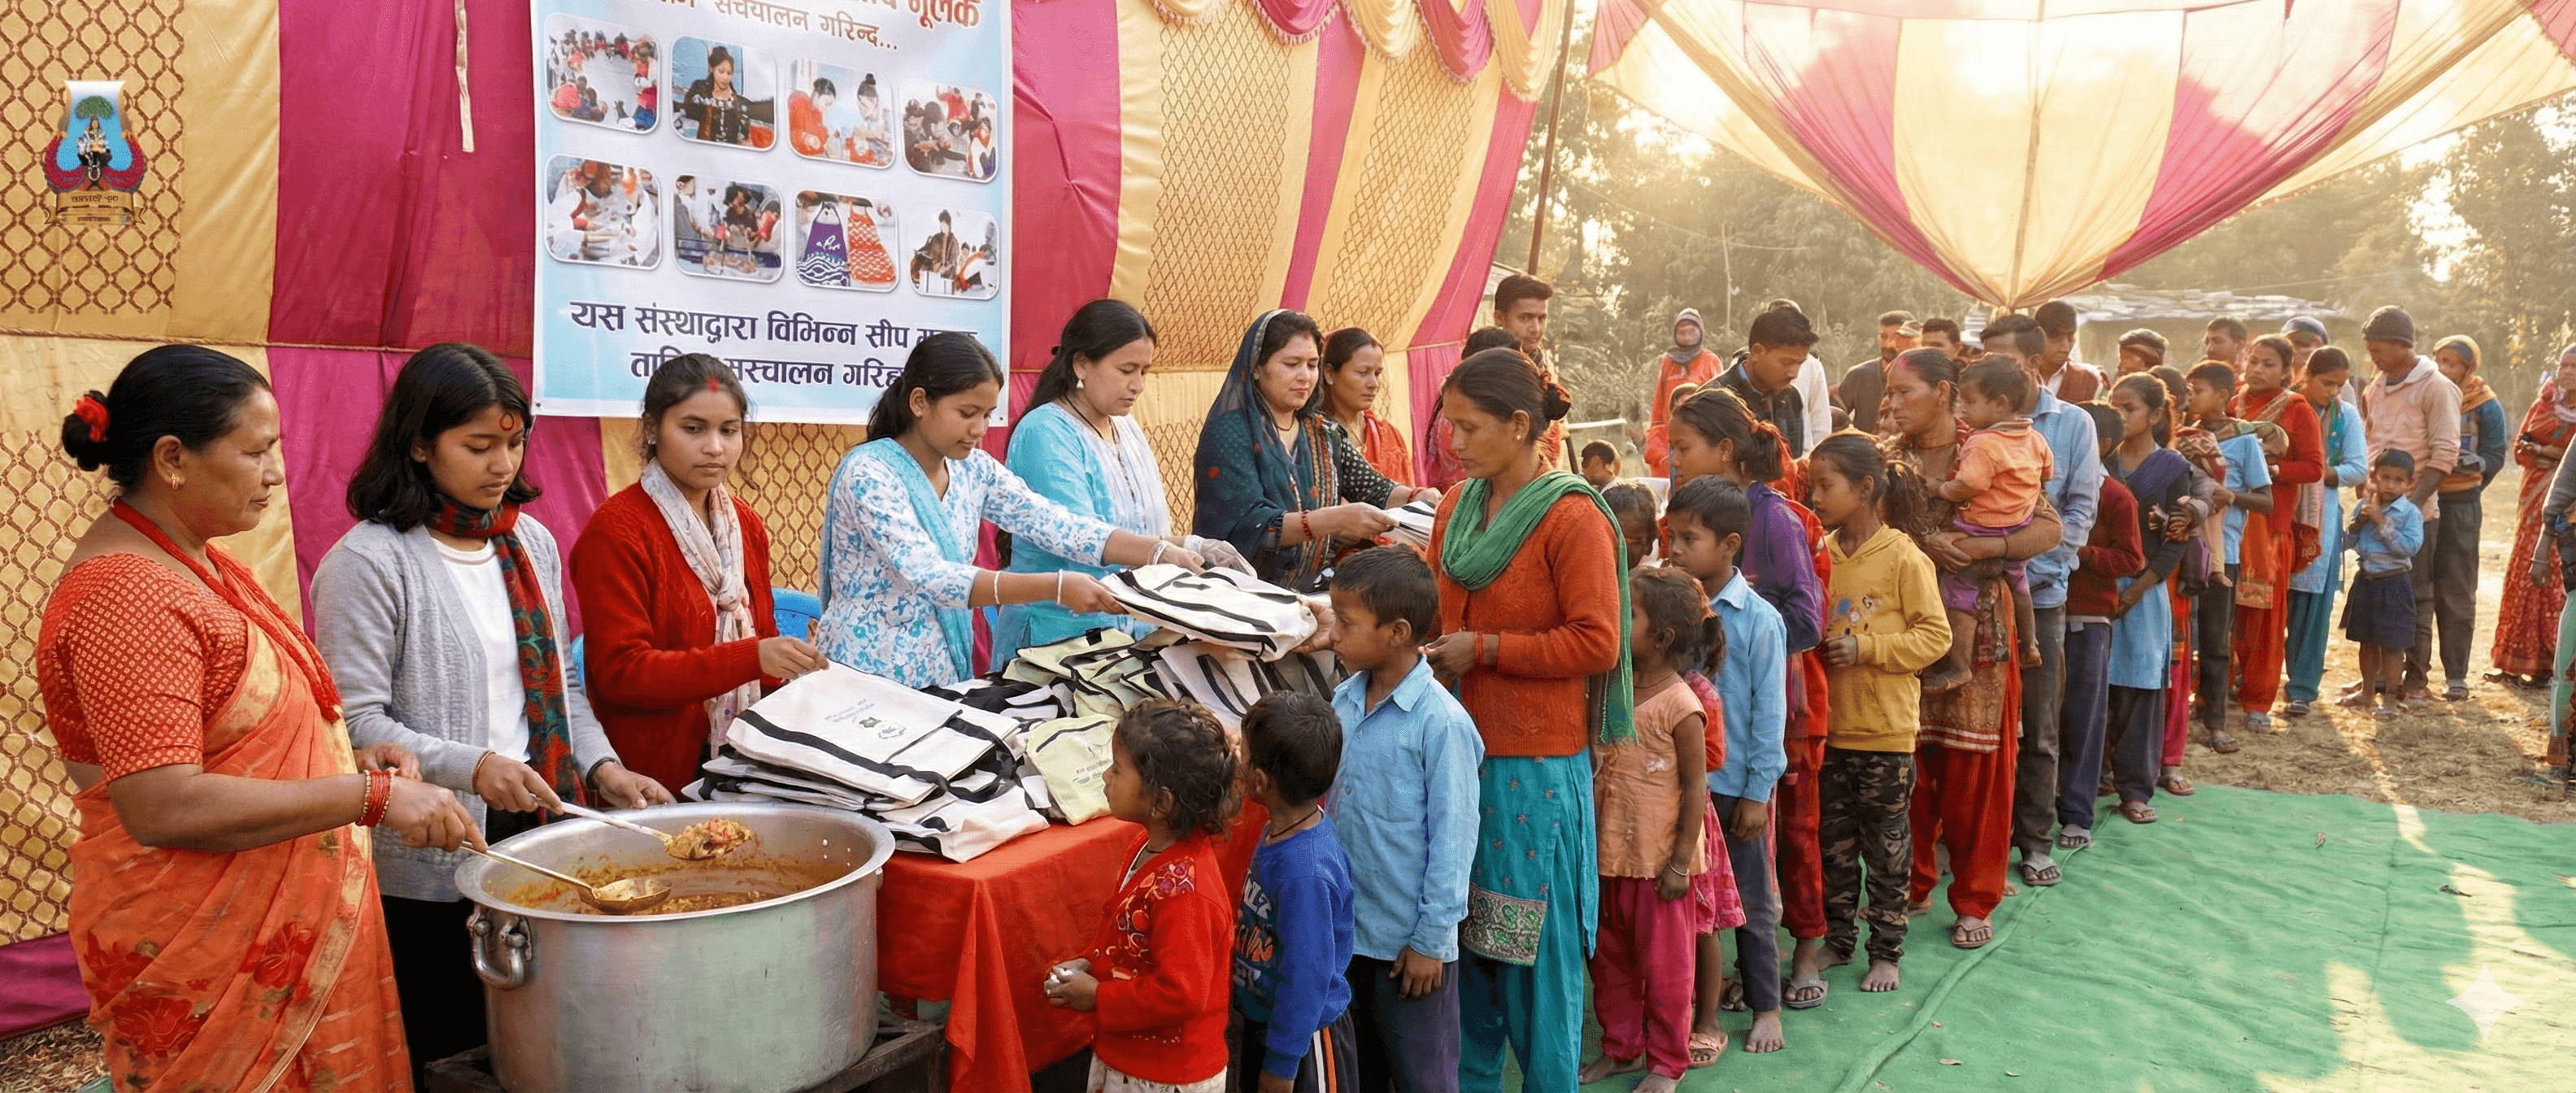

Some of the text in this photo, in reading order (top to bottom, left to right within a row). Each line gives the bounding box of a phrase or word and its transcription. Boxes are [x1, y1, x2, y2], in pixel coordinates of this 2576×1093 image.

[569, 302, 626, 331] यस
[634, 302, 759, 343] संस्थाद्वारा
[768, 310, 858, 345] विभिन्न
[866, 319, 910, 348] सीप
